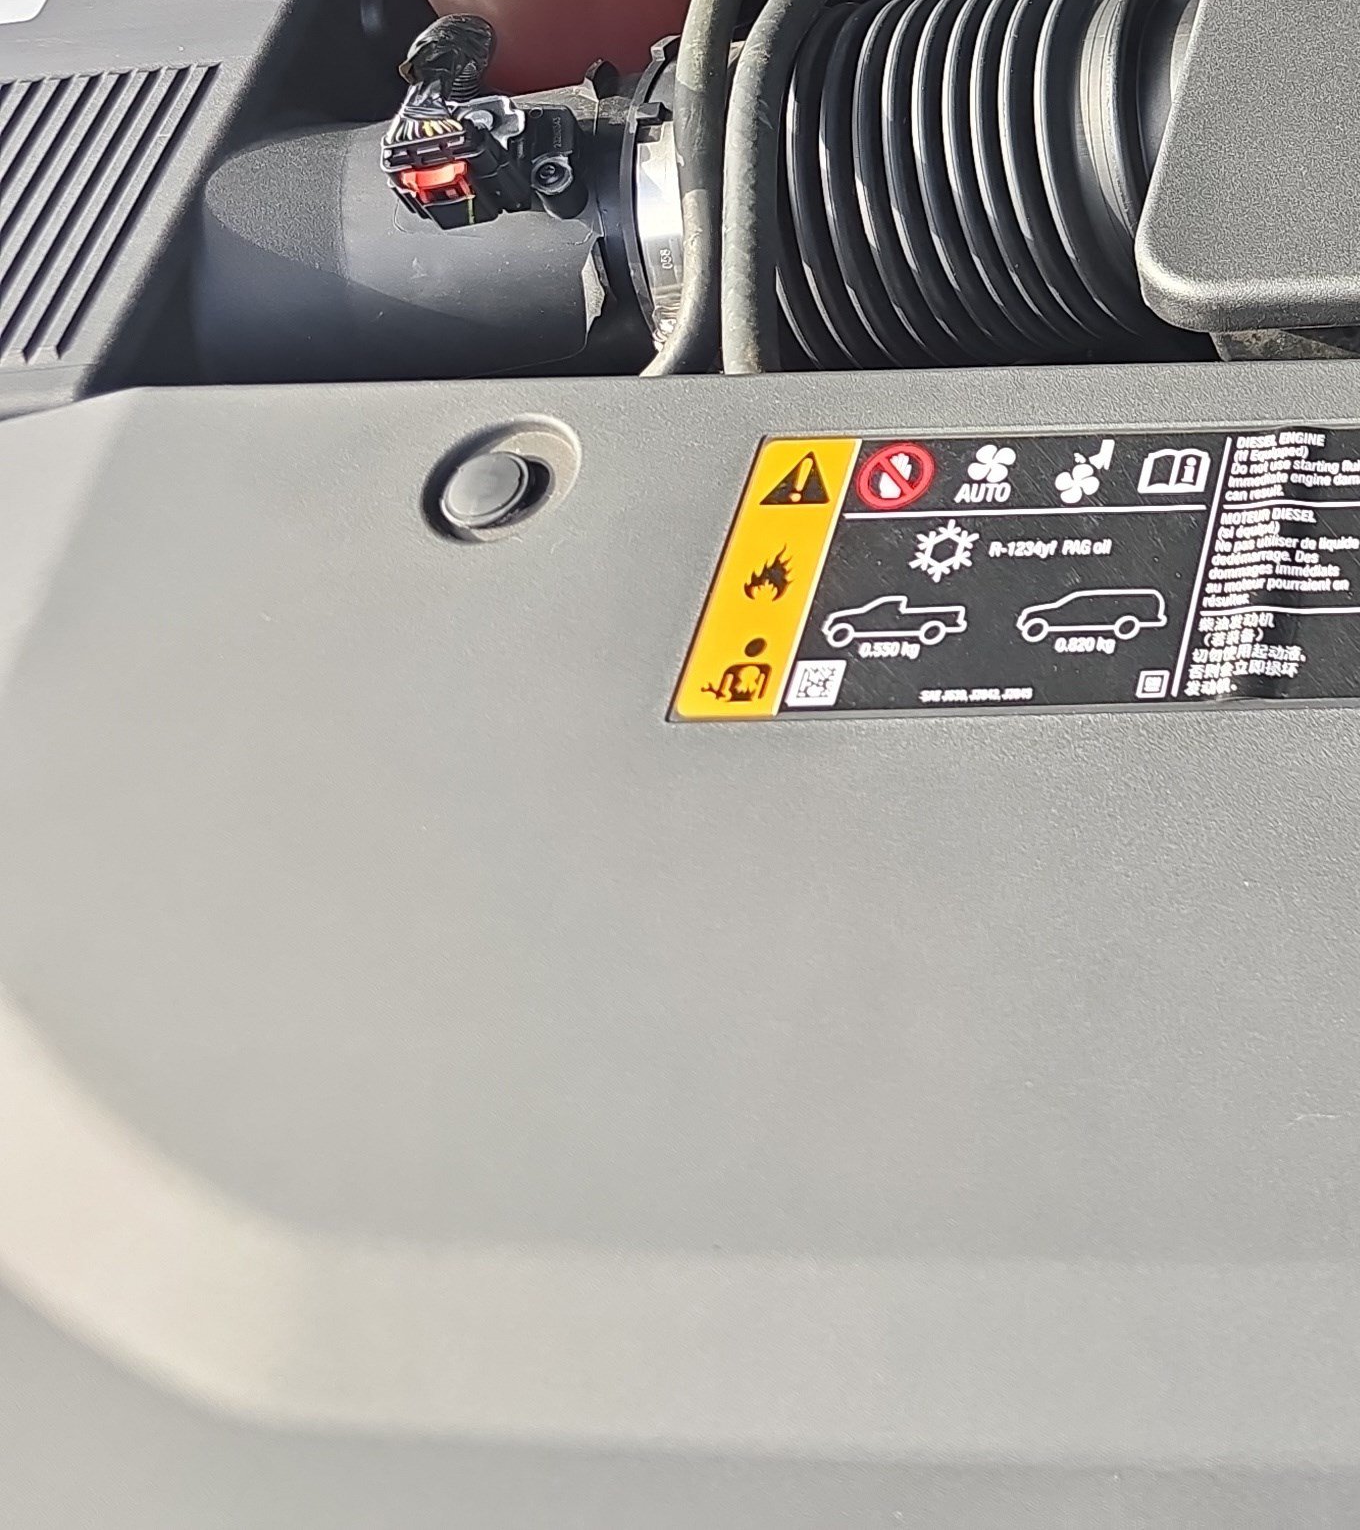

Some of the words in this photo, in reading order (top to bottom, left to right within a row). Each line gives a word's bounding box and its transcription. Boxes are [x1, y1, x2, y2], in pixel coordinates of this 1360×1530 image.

[1236, 434, 1277, 449] DIESEL
[1278, 432, 1325, 447] ENGINE
[1230, 463, 1248, 475] Do
[1249, 461, 1268, 475] not
[1270, 459, 1291, 472] use
[1293, 459, 1340, 475] starting
[1290, 472, 1331, 487] engine
[954, 482, 1011, 504] AUTO
[1224, 489, 1247, 501] can
[1220, 508, 1271, 525] MOTEUR
[1271, 507, 1317, 523] DIESEL
[988, 539, 1058, 559] R-1234yf
[1062, 539, 1092, 556] PAG
[1093, 538, 1112, 556] oil
[1214, 539, 1232, 553] Ne
[1233, 538, 1256, 553] pas
[1256, 534, 1299, 549] utiliser
[1300, 537, 1317, 550] de
[1318, 536, 1360, 552] liquide
[1294, 550, 1320, 564] Des
[1208, 563, 1273, 580] dommages
[1205, 581, 1222, 594] au
[1223, 577, 1266, 593] moteur
[1266, 576, 1331, 592] pourraient
[1332, 579, 1350, 591] en
[900, 642, 921, 660] kg
[1096, 637, 1116, 654] kg
